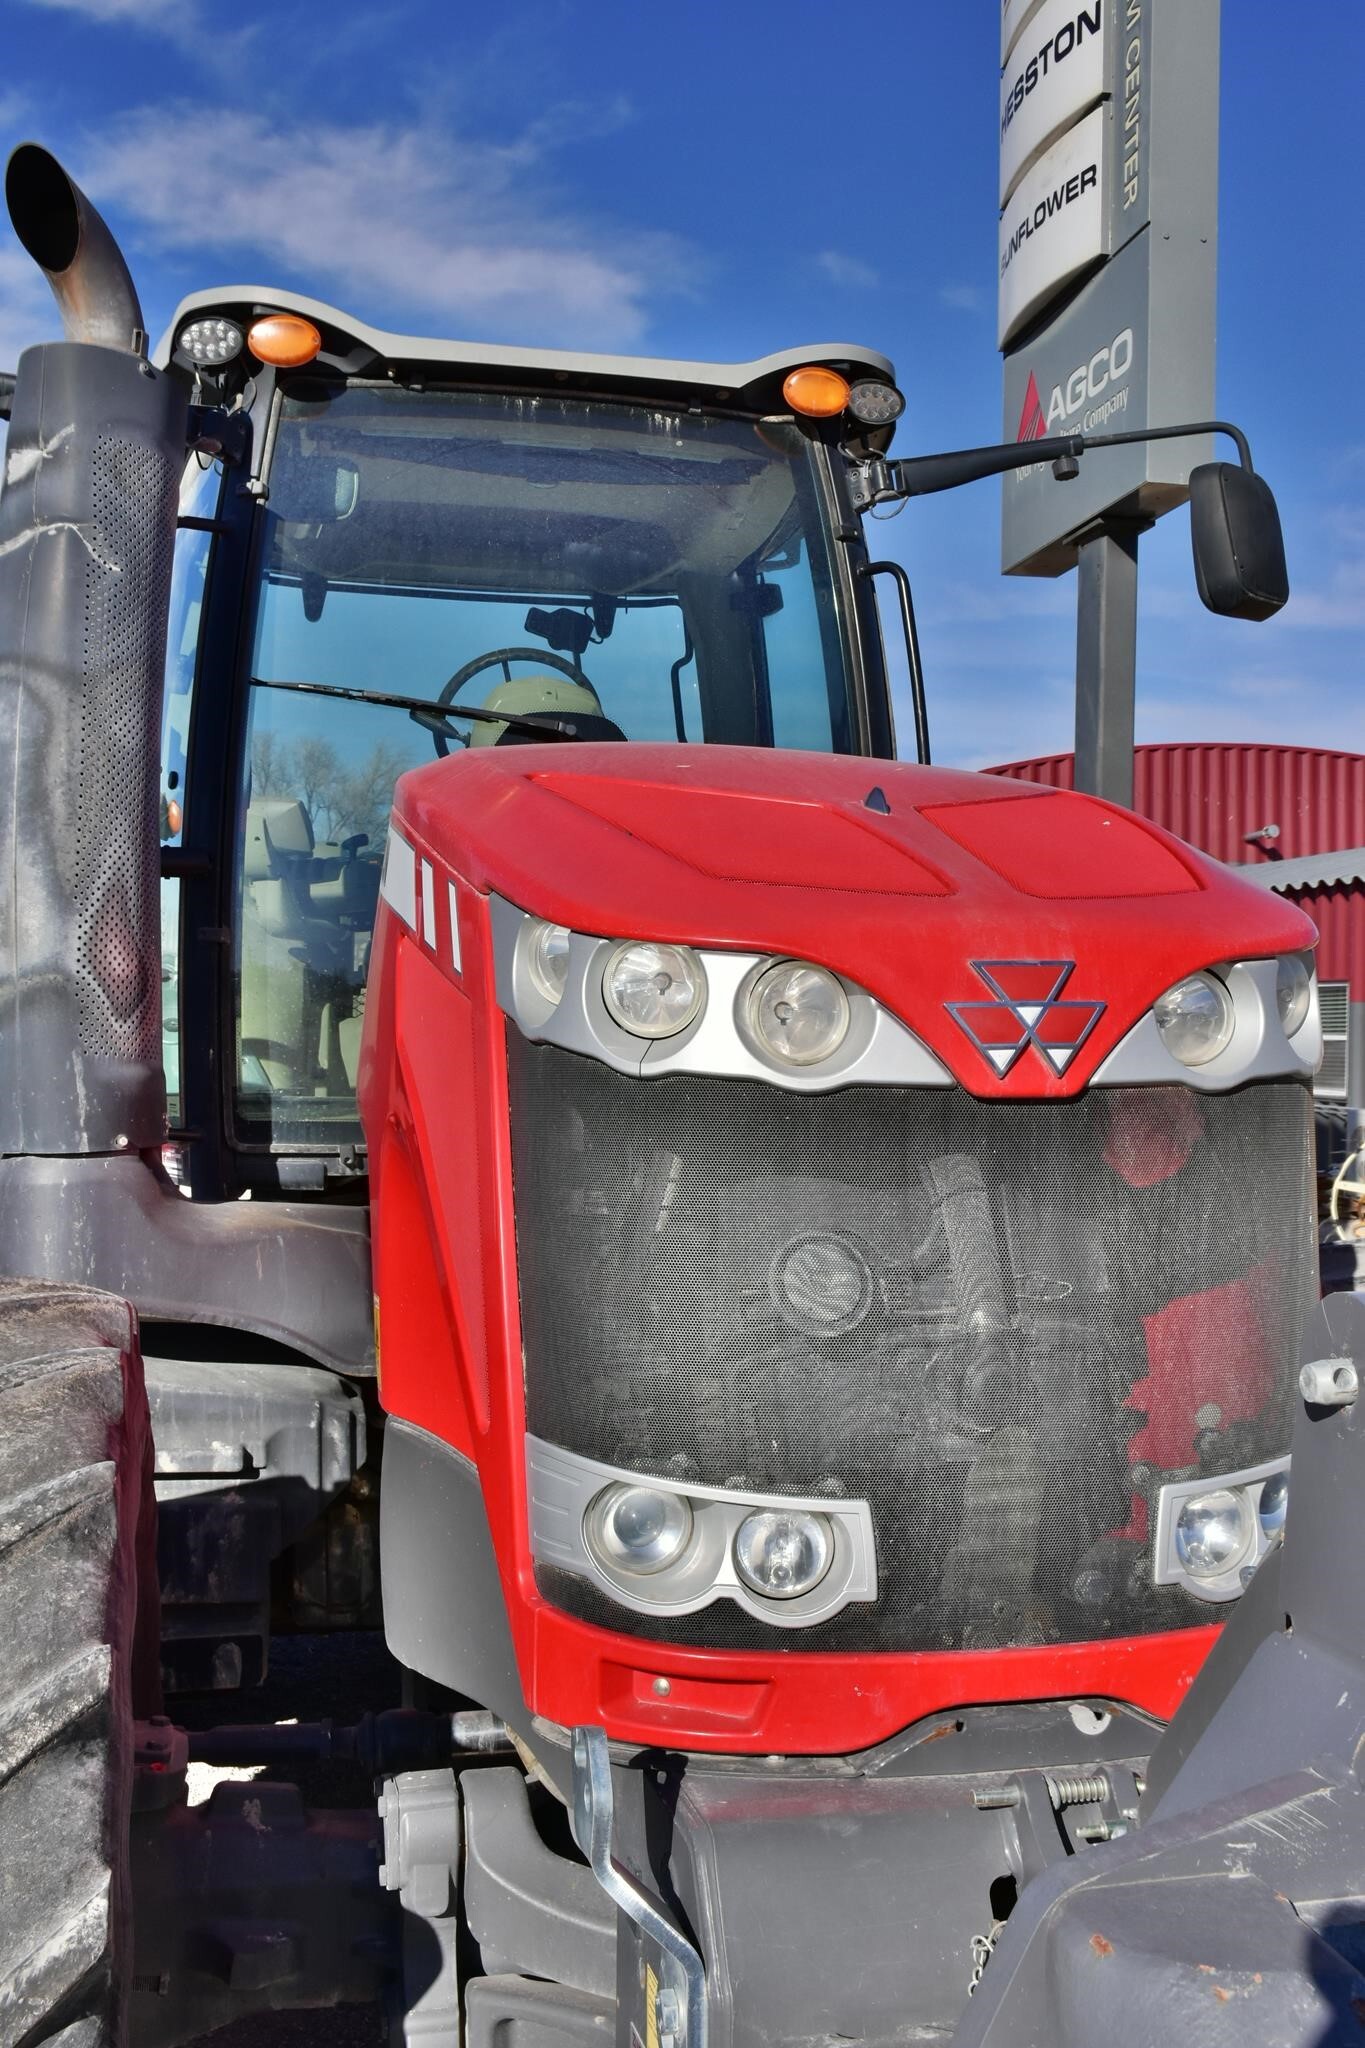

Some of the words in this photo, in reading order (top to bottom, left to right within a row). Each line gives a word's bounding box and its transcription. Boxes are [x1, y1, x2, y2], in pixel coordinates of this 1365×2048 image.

[1001, 0, 1102, 144] HESSTON
[1123, 37, 1142, 210] CENTER
[1000, 164, 1097, 279] SUNFLOWER
[1046, 327, 1134, 430] AGCO
[1083, 386, 1129, 432] Company
